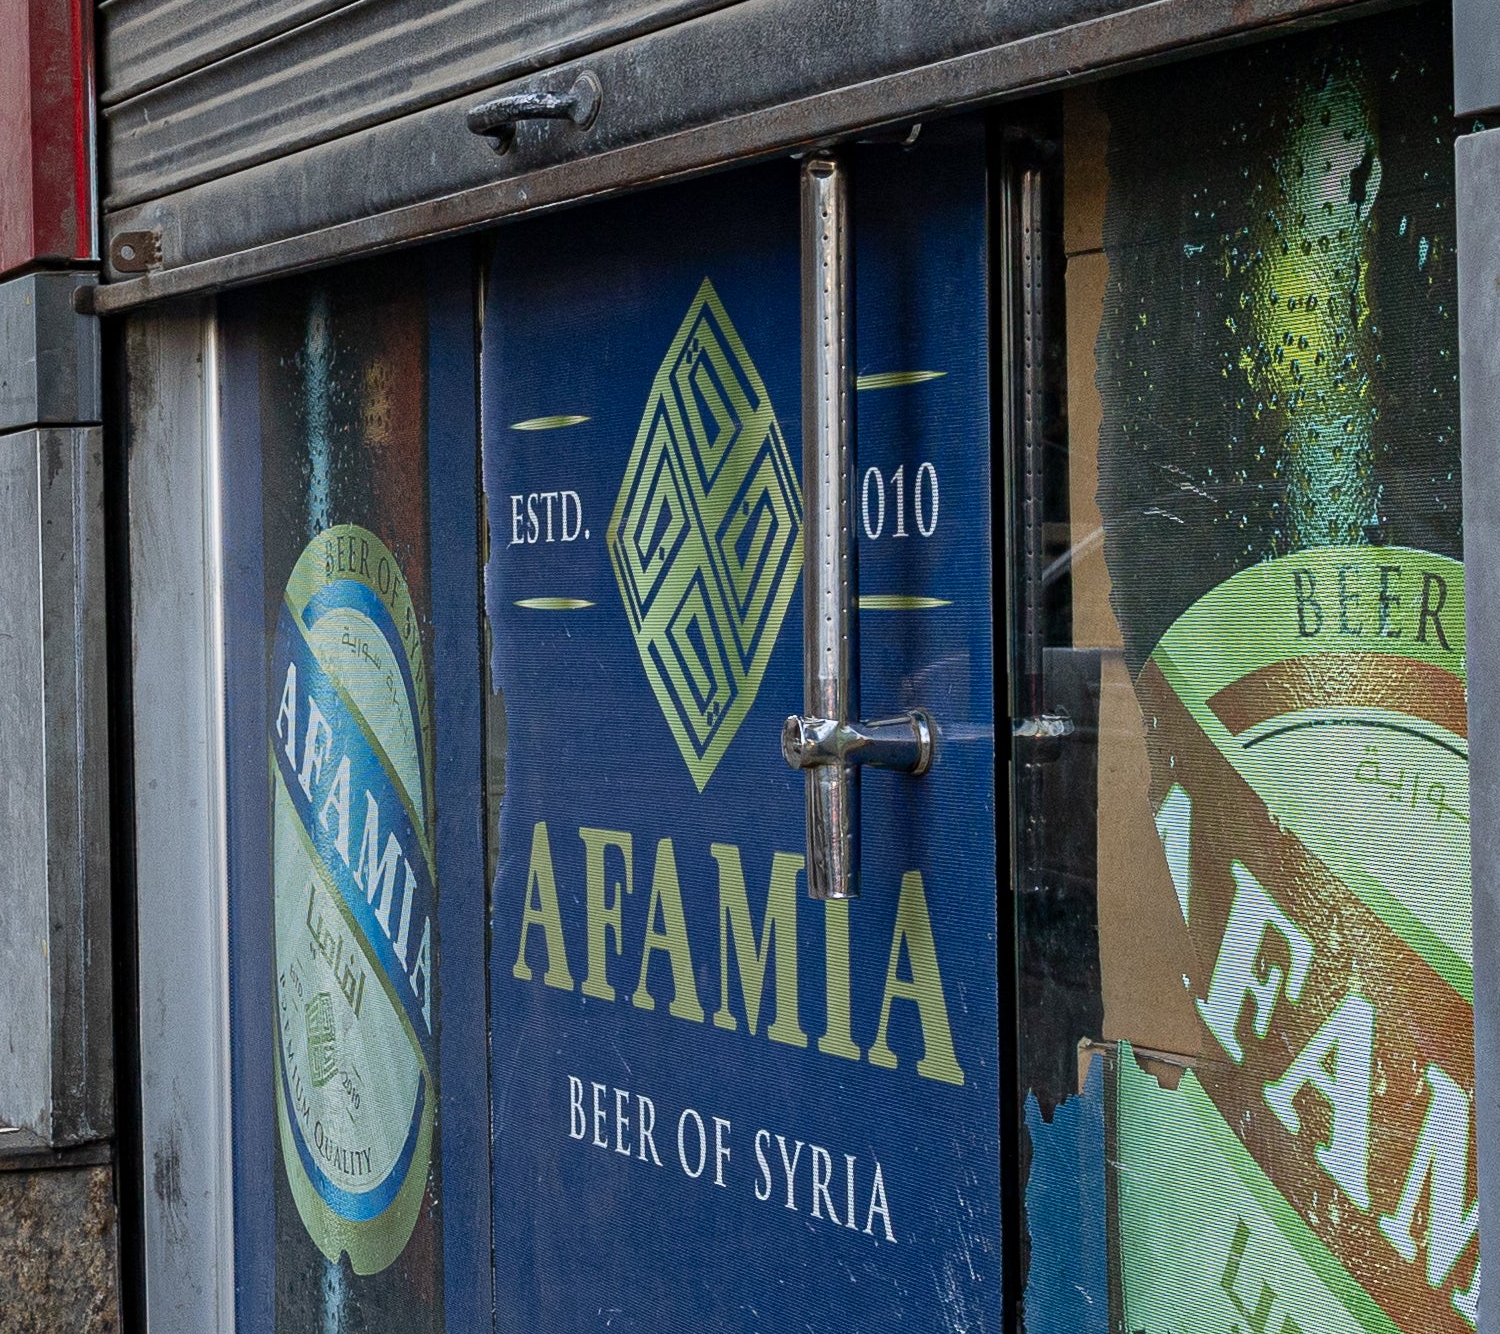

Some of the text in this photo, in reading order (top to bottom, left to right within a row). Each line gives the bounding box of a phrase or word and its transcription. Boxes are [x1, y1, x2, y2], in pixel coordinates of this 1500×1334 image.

[508, 462, 940, 546] ESTD. 010
[324, 534, 371, 579] BEER
[377, 556, 401, 608] OF
[1293, 565, 1451, 651] BEER
[276, 661, 433, 1036] AFAMIA
[513, 820, 966, 1087] AFAMIA
[312, 1120, 372, 1176] QUALITY
[567, 1072, 900, 1244] BEER OF SYRIA
